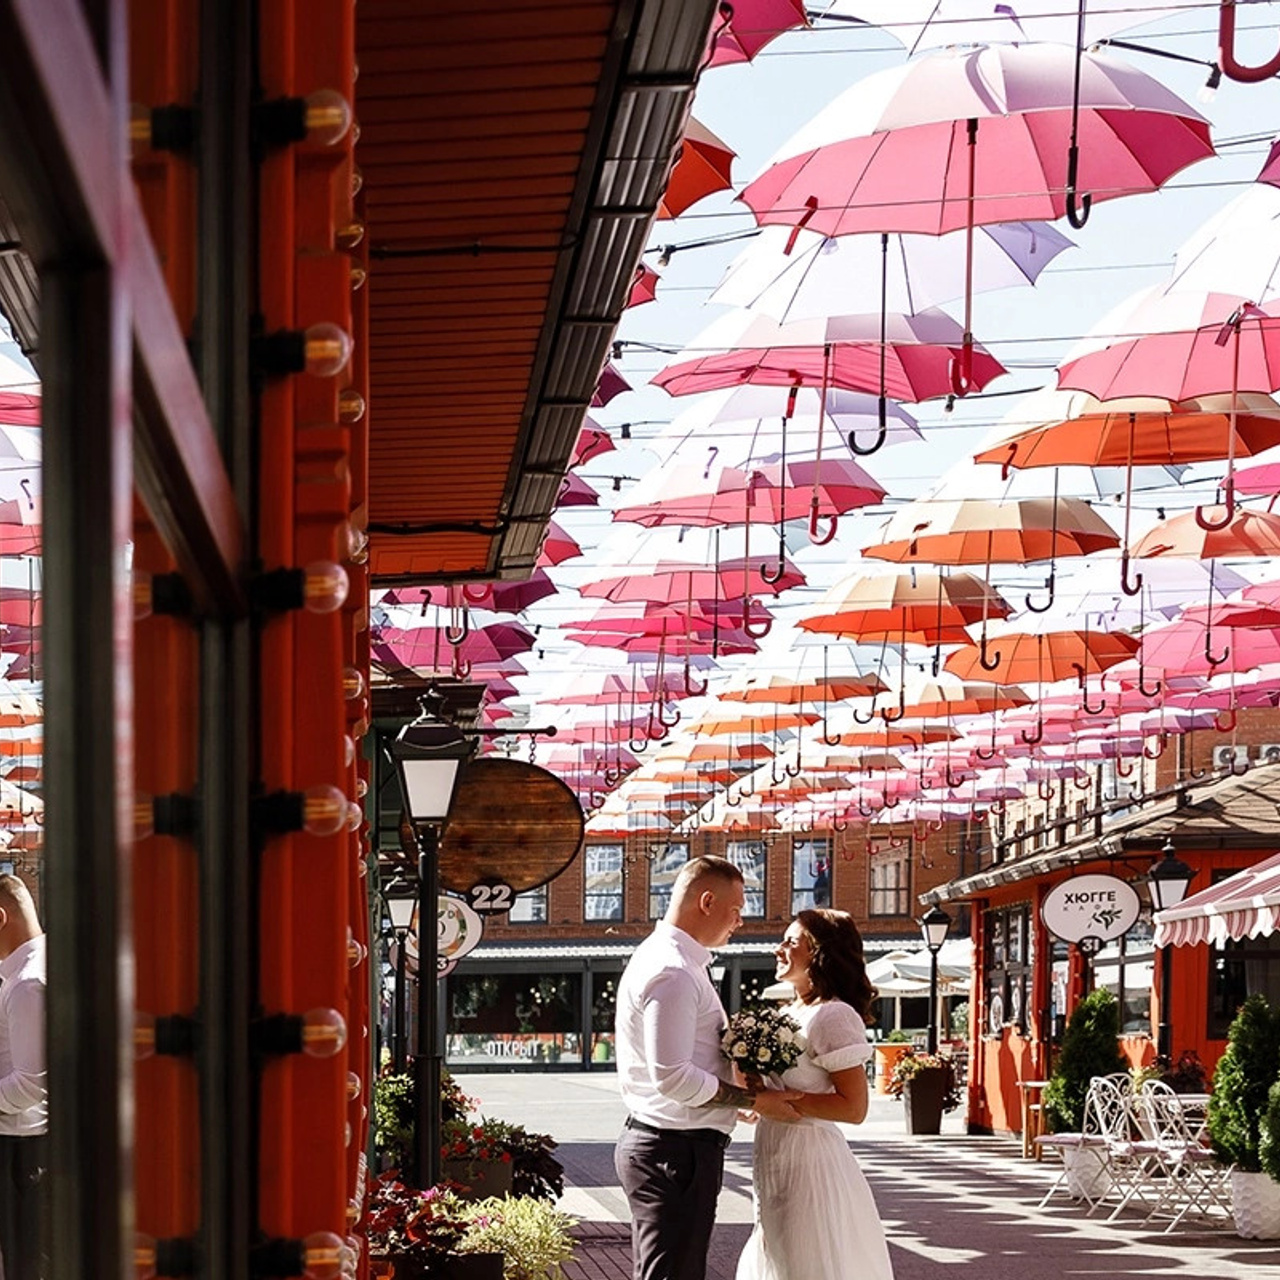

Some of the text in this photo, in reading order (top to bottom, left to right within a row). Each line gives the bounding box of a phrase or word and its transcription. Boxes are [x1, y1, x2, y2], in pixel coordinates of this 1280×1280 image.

[471, 884, 512, 909] 22
[1064, 891, 1116, 904] ХЮГГЕ
[1081, 939, 1100, 952] 31
